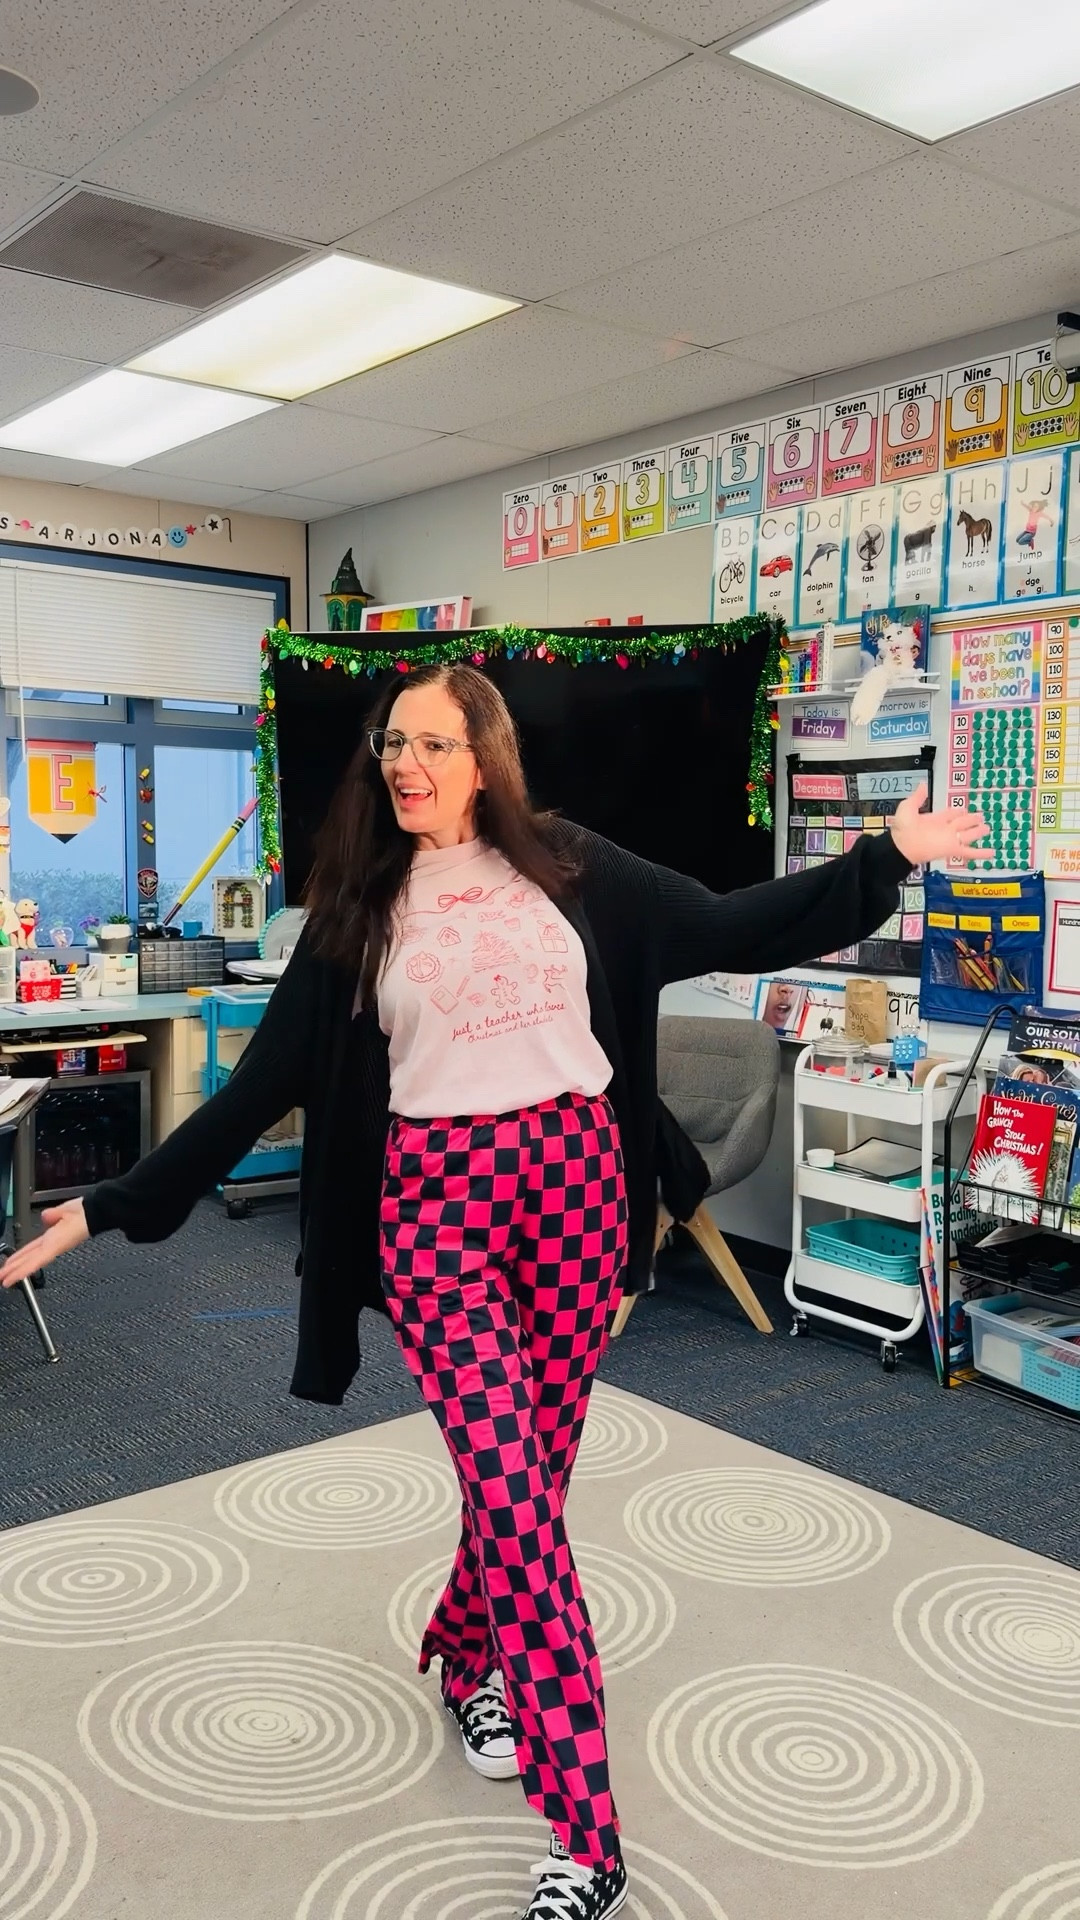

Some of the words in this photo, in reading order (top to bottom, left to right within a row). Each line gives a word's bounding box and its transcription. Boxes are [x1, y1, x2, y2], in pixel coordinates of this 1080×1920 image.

[1037, 349, 1051, 365] Te
[963, 366, 992, 383] Nine
[897, 383, 928, 401] Eight
[1026, 369, 1069, 410] 10
[834, 399, 867, 417] Seven
[964, 385, 985, 423] 9
[785, 417, 801, 429] Six
[900, 402, 920, 440] 8
[730, 431, 750, 445] Five
[840, 417, 859, 455] 7
[679, 444, 700, 459] Four
[783, 432, 801, 468] 6
[631, 457, 656, 472] Three
[730, 446, 748, 481] 5
[592, 471, 608, 483] Two
[681, 460, 698, 493] 4
[552, 482, 568, 494] One
[635, 472, 650, 506] 3
[513, 493, 530, 505] Zero
[593, 485, 606, 517] 2
[553, 496, 563, 526] 1
[514, 506, 528, 536] 0
[38, 523, 162, 546] ARJONA
[962, 558, 986, 569] horse
[1017, 550, 1043, 563] jump
[862, 575, 875, 584] fan
[905, 566, 932, 579] gorilla
[769, 590, 781, 598] car
[806, 581, 834, 593] dolphin
[720, 595, 744, 605] bicycle
[1050, 625, 1062, 635] 90
[963, 634, 990, 650] How
[993, 631, 1032, 647] many
[1049, 644, 1063, 655] 100
[962, 651, 996, 669] days
[998, 647, 1032, 664] have
[968, 670, 988, 683] we
[990, 666, 1025, 681] been
[1048, 664, 1062, 675] 110
[977, 678, 1031, 700] school?
[1047, 684, 1062, 695] 120
[802, 706, 829, 718] Today
[831, 707, 841, 717] is:
[877, 701, 916, 712] morrow
[957, 717, 967, 727] 10
[1047, 710, 1061, 720] 130
[801, 719, 836, 738] Friday
[871, 716, 928, 737] Saturday
[955, 736, 967, 746] 20
[1046, 730, 1061, 740] 140
[955, 754, 966, 764] 30
[1045, 749, 1060, 760] 150
[954, 773, 966, 783] 40
[1044, 769, 1059, 779] 160
[50, 754, 75, 811] E
[794, 779, 843, 794] December
[870, 777, 913, 794] 2025
[952, 797, 964, 807] 50
[1042, 795, 1056, 805] 170
[1041, 814, 1055, 824] 180
[830, 834, 839, 851] 2
[1050, 848, 1066, 859] THE
[962, 887, 980, 896] Let's
[982, 887, 1008, 896] Count
[907, 891, 924, 907] 20
[881, 918, 898, 935] 26
[905, 917, 921, 936] 27
[1011, 919, 1031, 928] Ones
[843, 946, 855, 961] 31
[848, 1004, 869, 1023] Shape
[452, 1022, 472, 1041] just
[485, 1010, 523, 1028] teacher
[851, 1021, 866, 1038] Bag
[1026, 1026, 1050, 1038] OUR
[1032, 1039, 1077, 1053] SYSTEM!
[987, 1116, 1014, 1129] GRINCH
[1004, 1128, 1026, 1140] STOLE
[934, 1207, 977, 1226] Rading
[936, 1219, 999, 1244] Fundations
